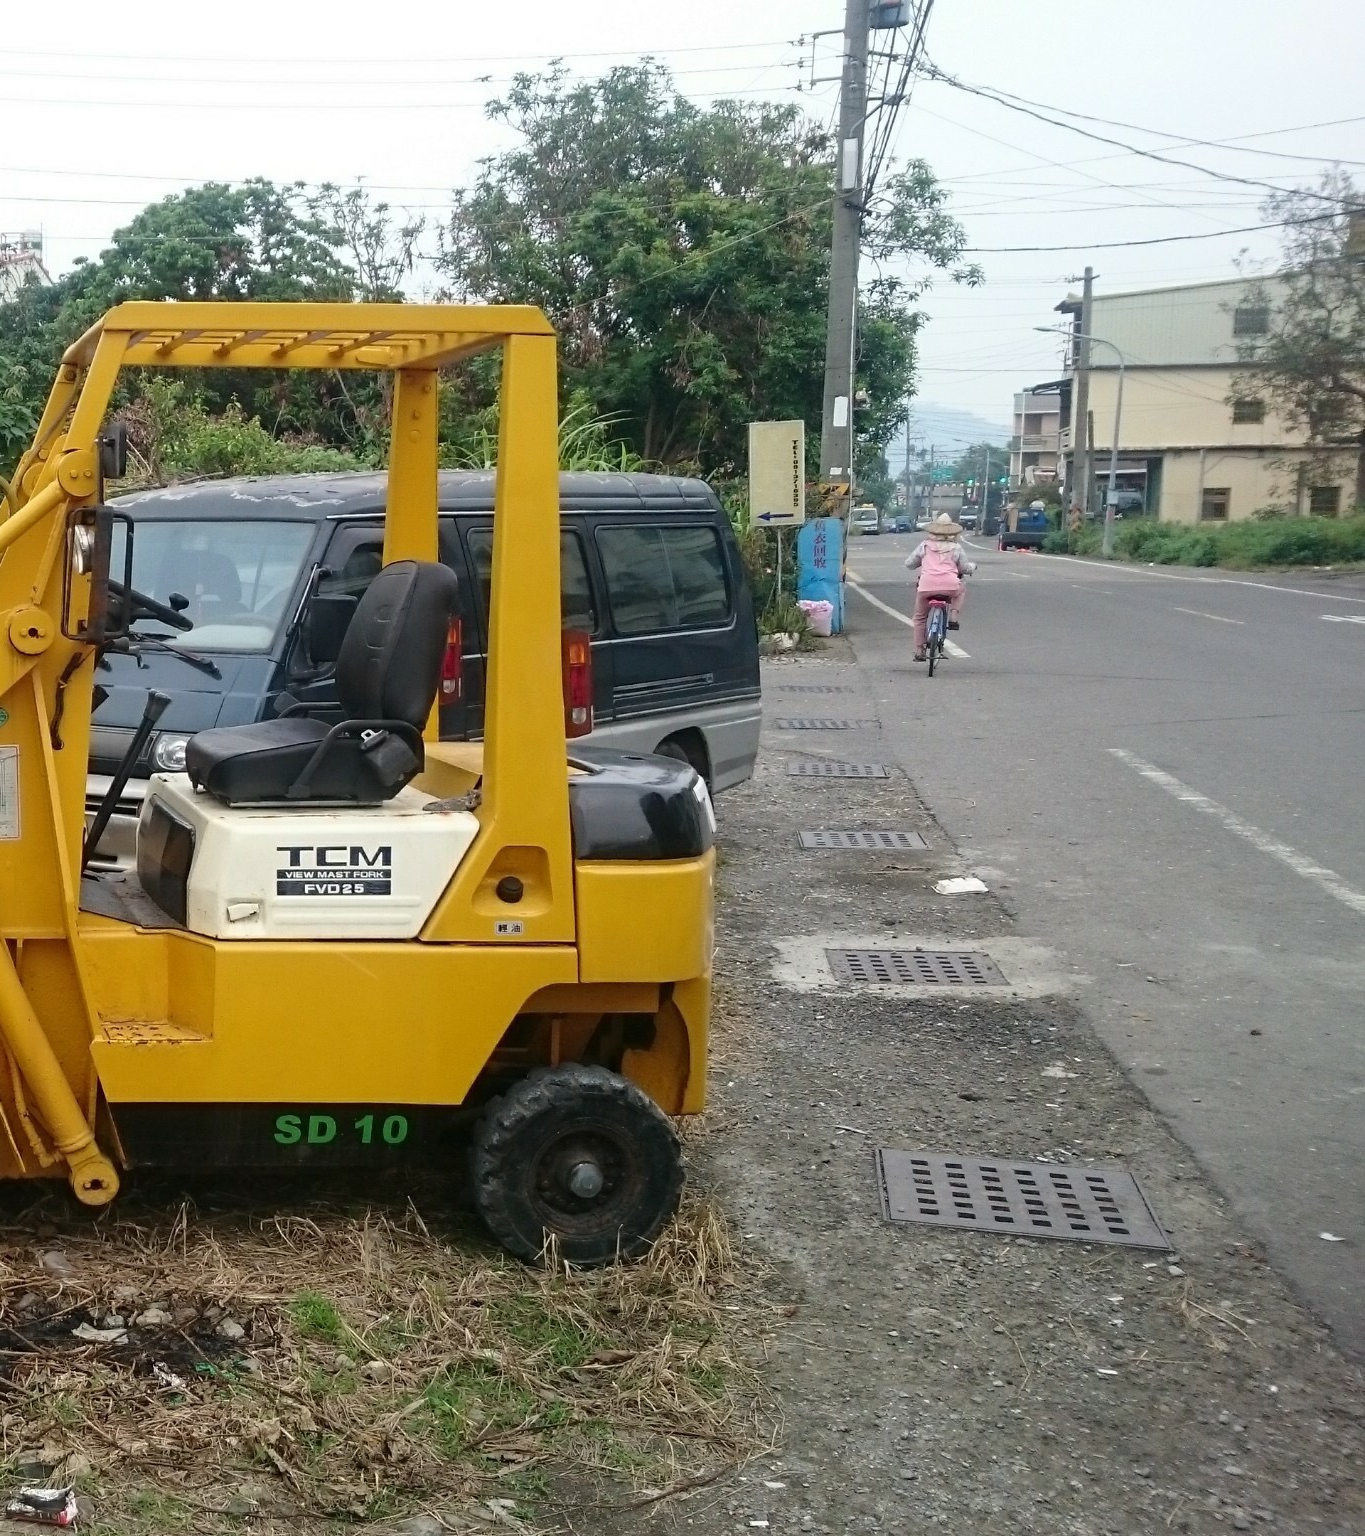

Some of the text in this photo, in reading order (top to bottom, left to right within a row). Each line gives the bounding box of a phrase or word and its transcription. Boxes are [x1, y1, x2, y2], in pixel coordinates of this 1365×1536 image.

[276, 846, 392, 867] TCM
[285, 871, 384, 879] VIEW MAST FORK
[273, 1114, 408, 1144] SD 10
